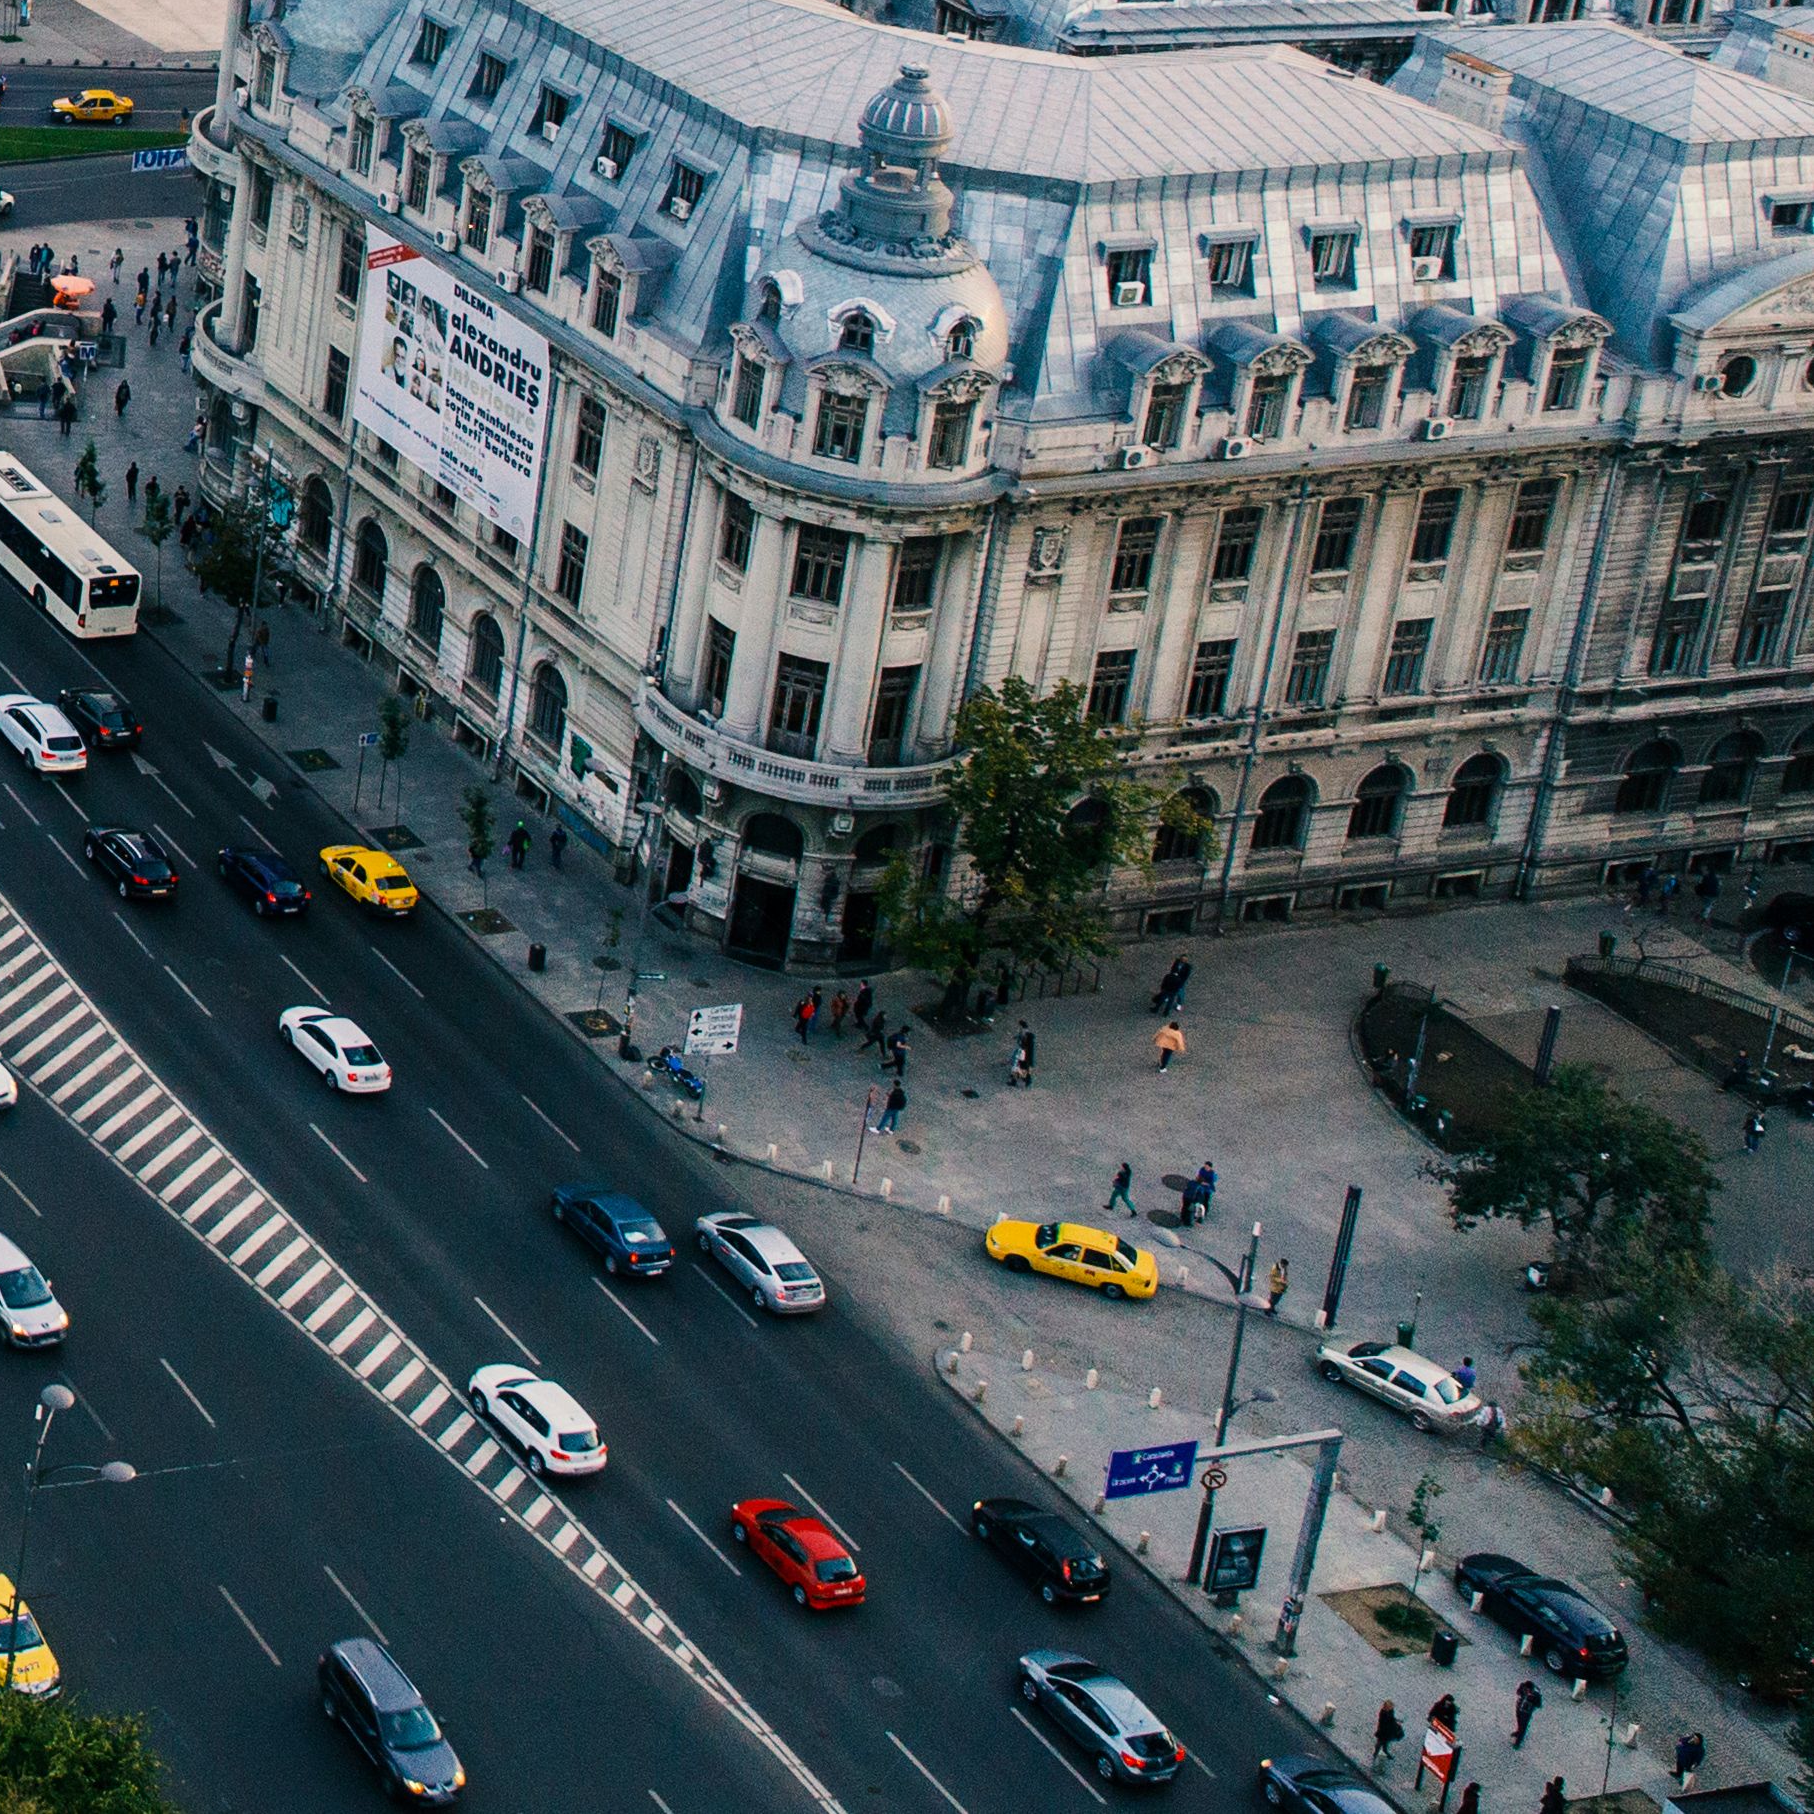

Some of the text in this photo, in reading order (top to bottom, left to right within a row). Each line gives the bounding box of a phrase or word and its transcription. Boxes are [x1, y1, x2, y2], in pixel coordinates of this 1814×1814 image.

[454, 284, 494, 320] DILEMA
[452, 313, 542, 381] alexandru
[445, 398, 471, 422] sorin
[474, 418, 532, 464] romanescu
[446, 381, 533, 451] ioana mintulescu
[455, 415, 481, 443] berti
[485, 436, 531, 478] barbera
[460, 462, 483, 483] radio
